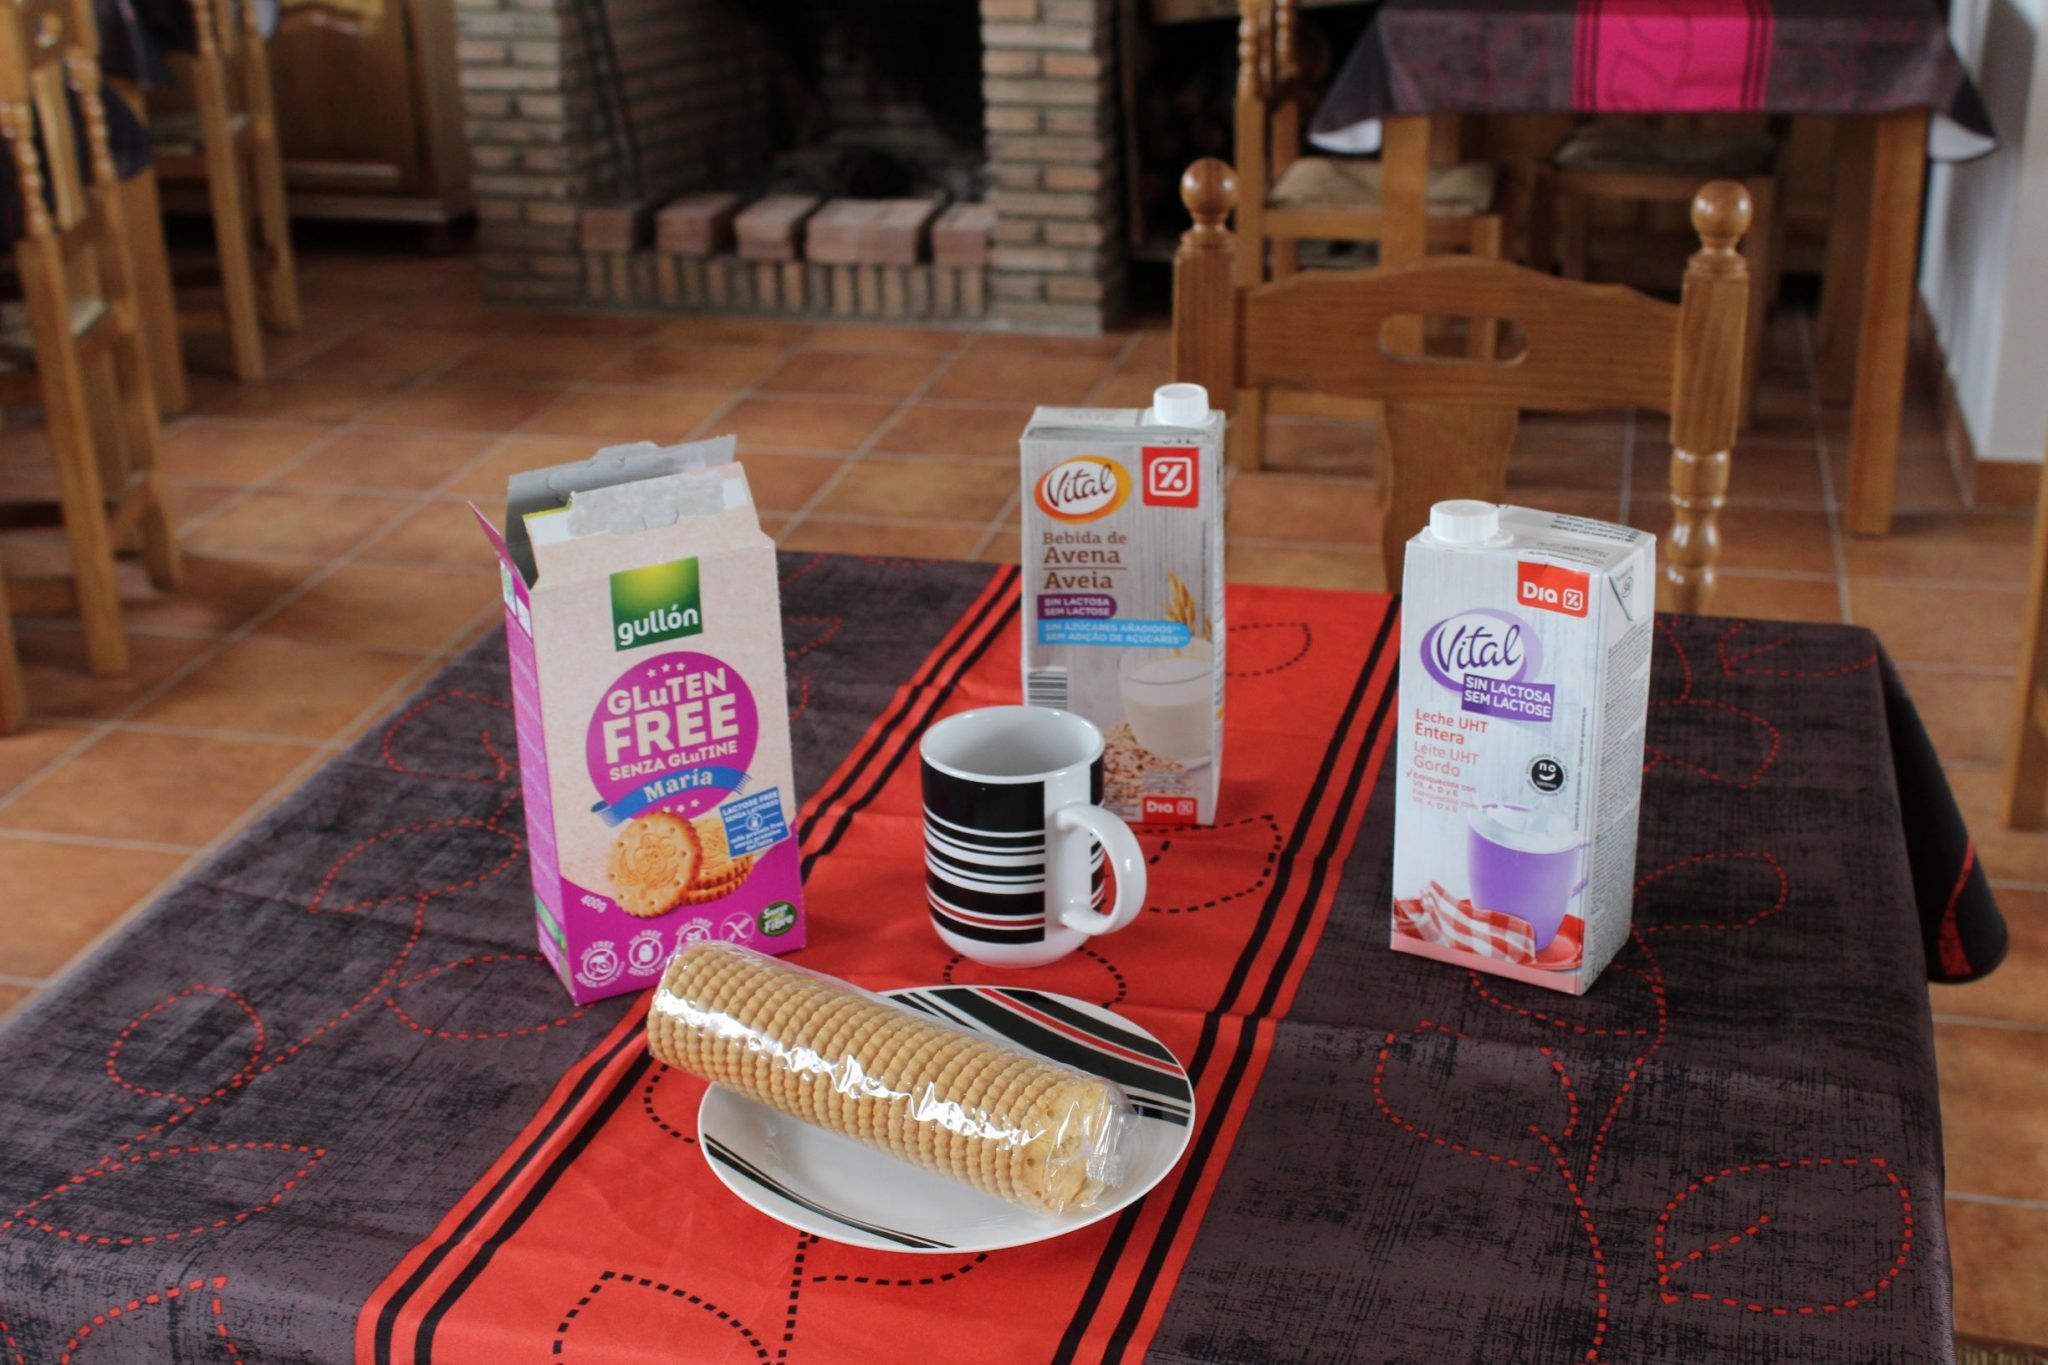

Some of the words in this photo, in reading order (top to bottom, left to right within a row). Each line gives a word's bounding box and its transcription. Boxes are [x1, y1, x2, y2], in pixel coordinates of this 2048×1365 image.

[1047, 464, 1114, 507] Vital
[1043, 531, 1102, 545] Bebida
[1107, 531, 1127, 545] de
[1043, 546, 1120, 564] Avena
[1043, 571, 1113, 589] Aveia
[1044, 597, 1061, 606] SIN
[1063, 597, 1110, 607] LACTOSA
[1044, 607, 1064, 616] SEM
[1066, 607, 1110, 616] LACTOSE
[617, 604, 699, 646] gullón
[1044, 623, 1062, 632] SIN
[1044, 632, 1065, 641] SEM
[1109, 634, 1123, 642] DE
[1437, 624, 1521, 673] Vital
[1465, 676, 1488, 691] SIN
[1490, 682, 1552, 704] LACTOSA
[1464, 690, 1490, 705] SEM
[1493, 697, 1551, 719] LACTOSE
[603, 693, 739, 764] FREE
[1416, 708, 1454, 727] Leche
[1459, 716, 1489, 733] UHT
[1415, 722, 1465, 745] Entera
[1414, 741, 1446, 759] Leite
[1450, 748, 1479, 766] UHT
[609, 757, 666, 782] SENZA
[1413, 754, 1461, 777] Gordo
[1538, 762, 1556, 773] no
[643, 768, 713, 803] María
[580, 894, 608, 913] 400g
